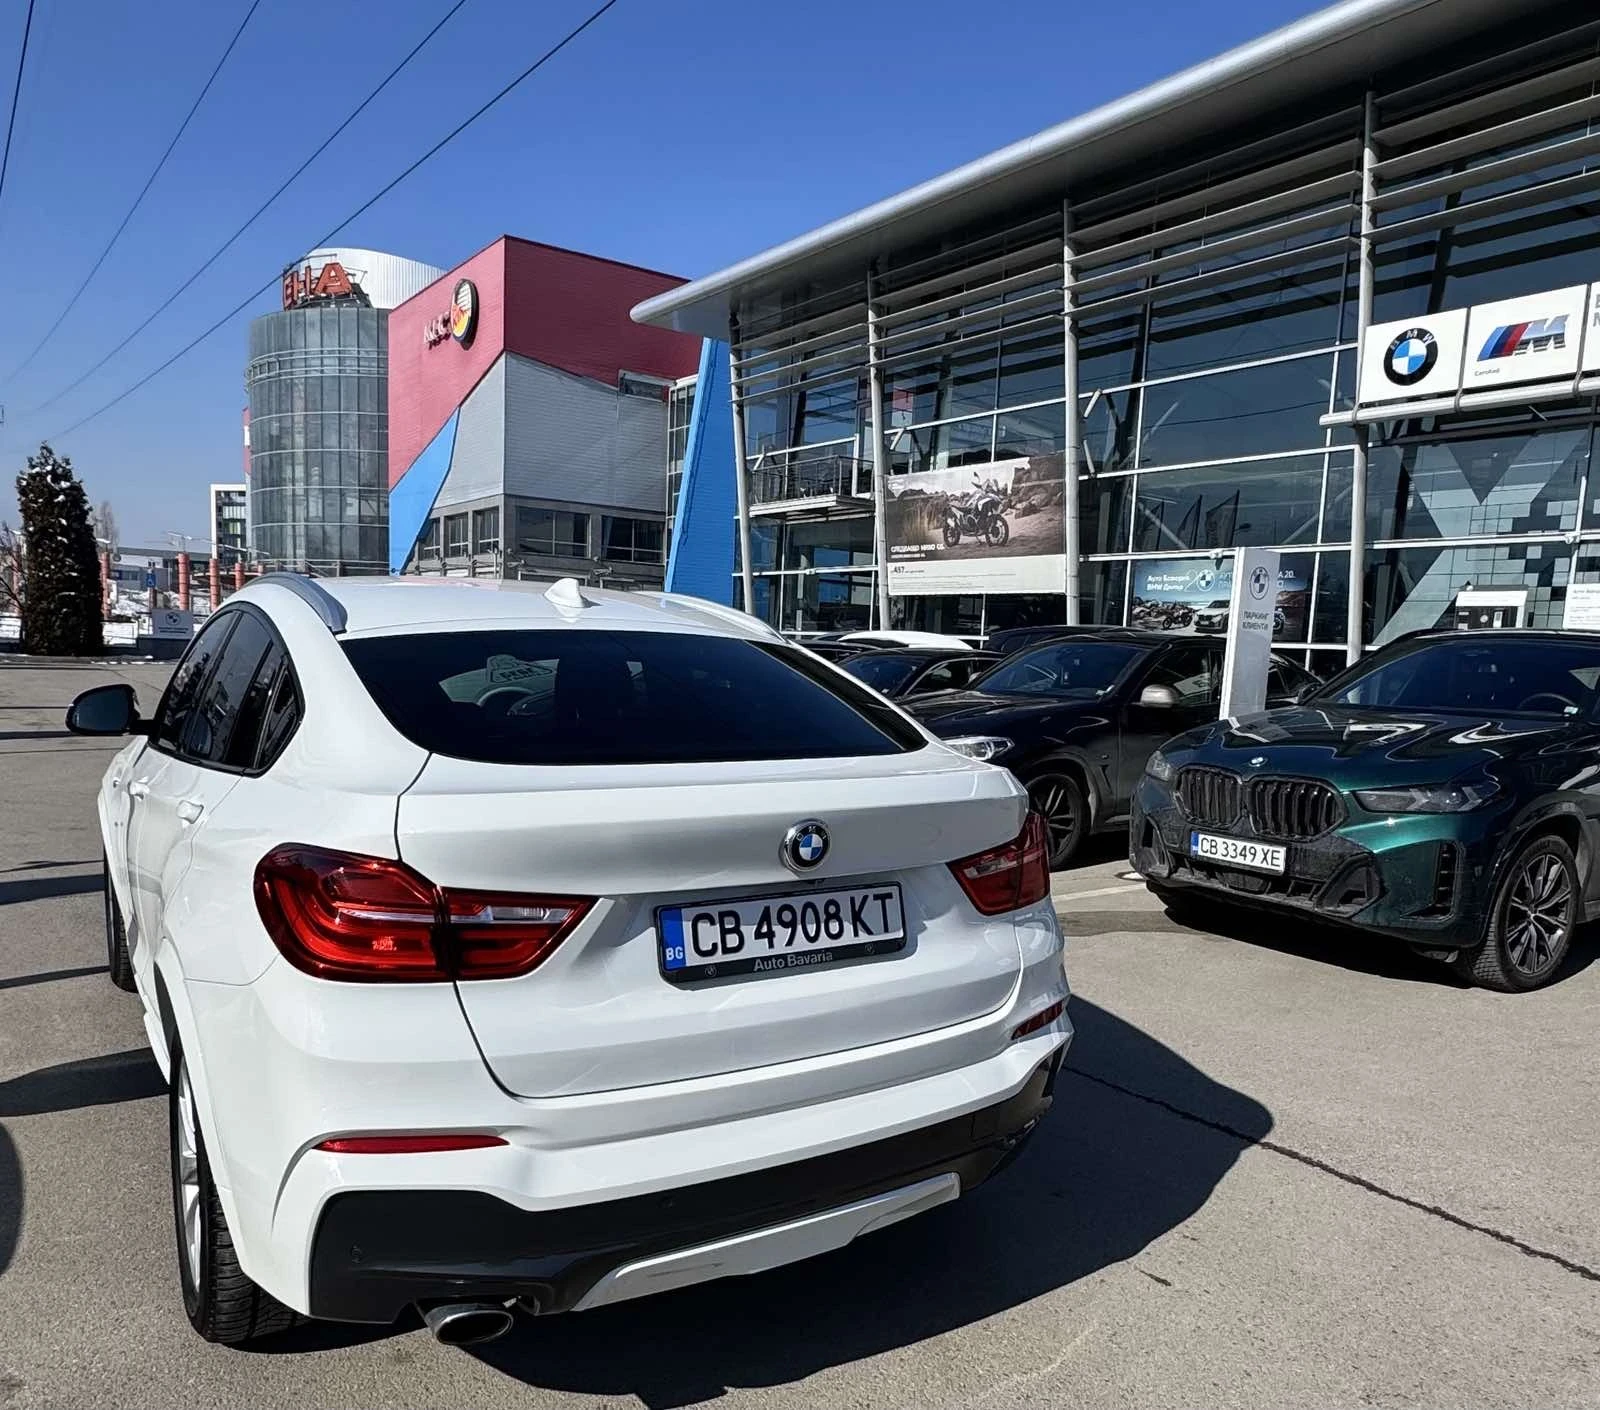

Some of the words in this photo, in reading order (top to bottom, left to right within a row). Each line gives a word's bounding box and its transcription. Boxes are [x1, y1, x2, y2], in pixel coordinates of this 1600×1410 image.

[1200, 837, 1218, 855] CB
[1221, 841, 1257, 862] 3349
[1260, 848, 1281, 867] XE
[691, 910, 745, 957] CB
[754, 899, 844, 949] 4908
[851, 892, 893, 938] KT
[665, 946, 684, 961] BG
[753, 956, 785, 972] Auto
[787, 950, 833, 968] Bavaria
